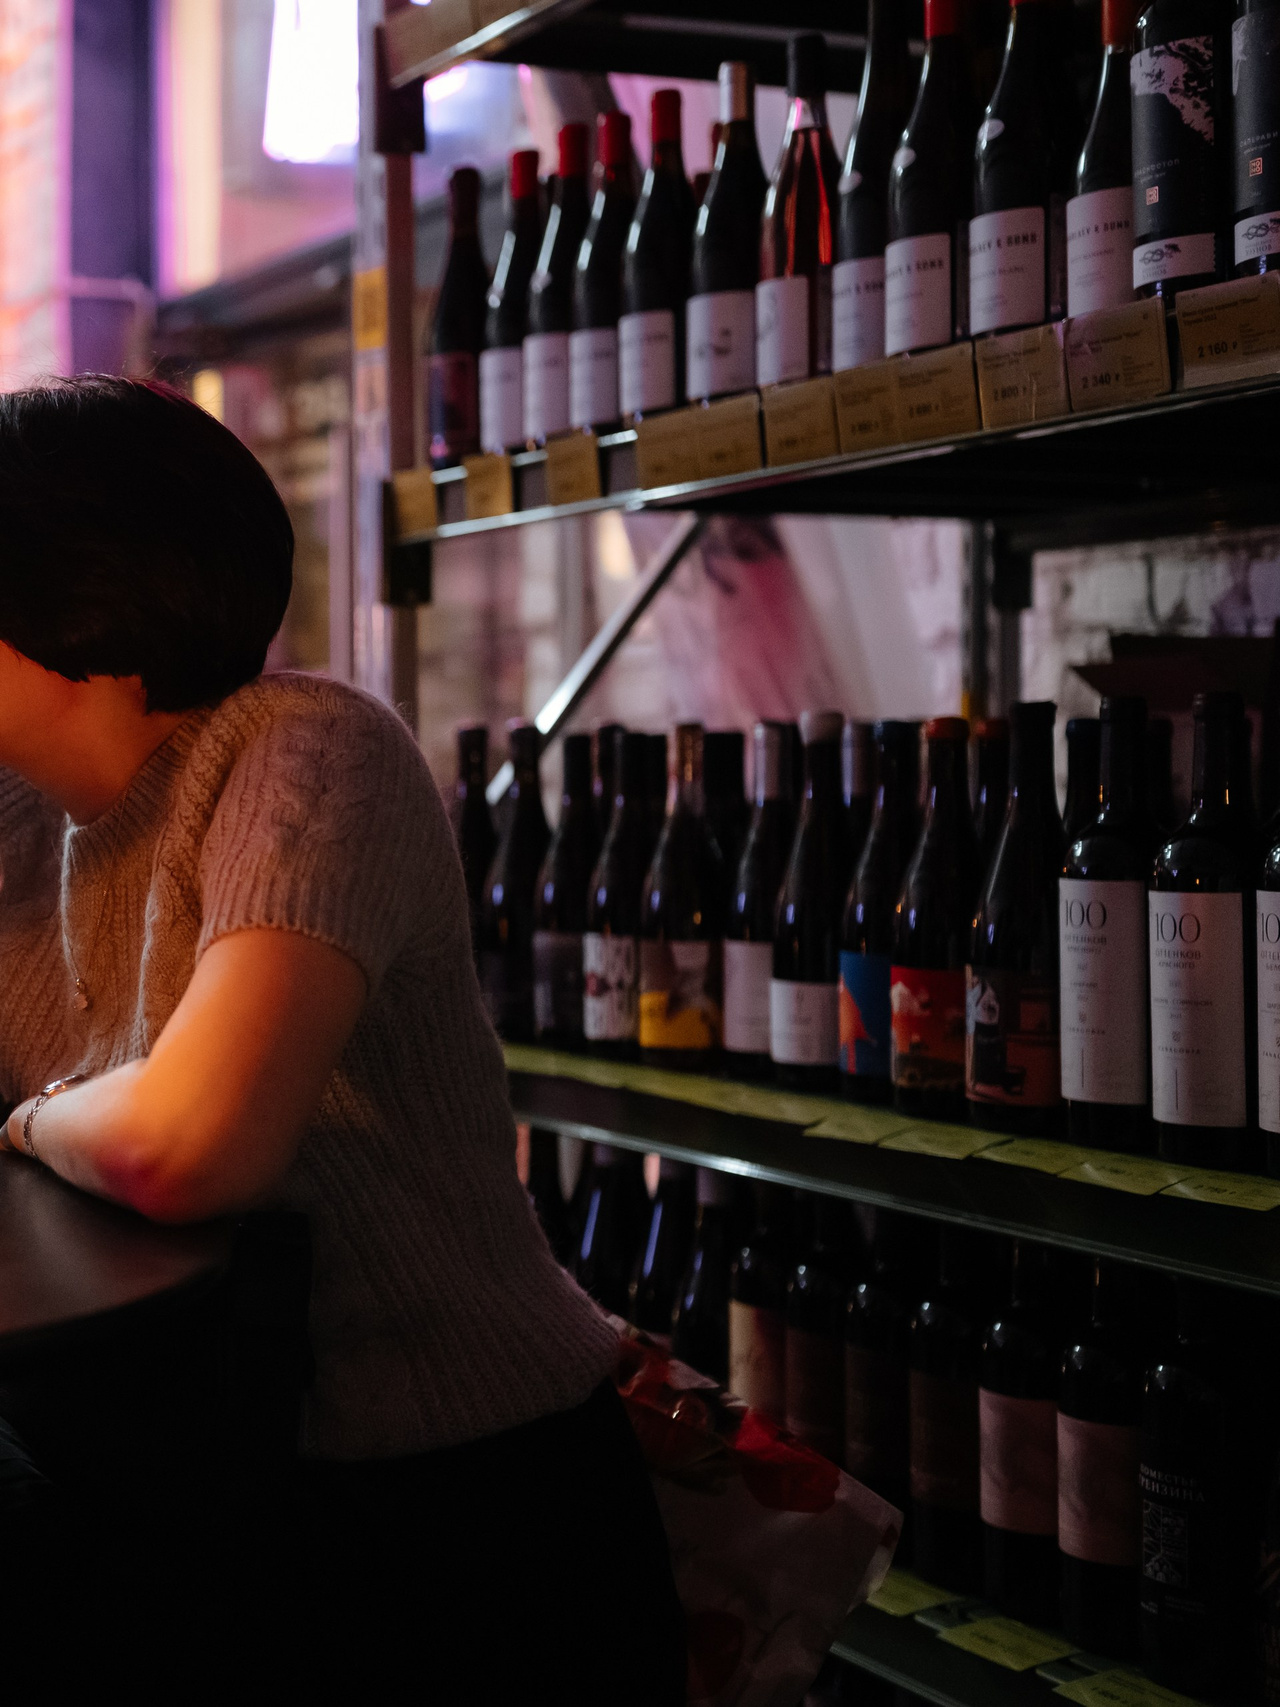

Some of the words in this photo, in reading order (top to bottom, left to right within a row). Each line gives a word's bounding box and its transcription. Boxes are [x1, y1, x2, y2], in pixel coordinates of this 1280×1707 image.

[1198, 346, 1205, 358] 2
[1208, 341, 1228, 356] 160
[1081, 376, 1089, 389] 2
[1092, 372, 1111, 387] 340
[1065, 899, 1107, 929] 100
[1155, 912, 1201, 944] 100
[1261, 912, 1280, 944] 10
